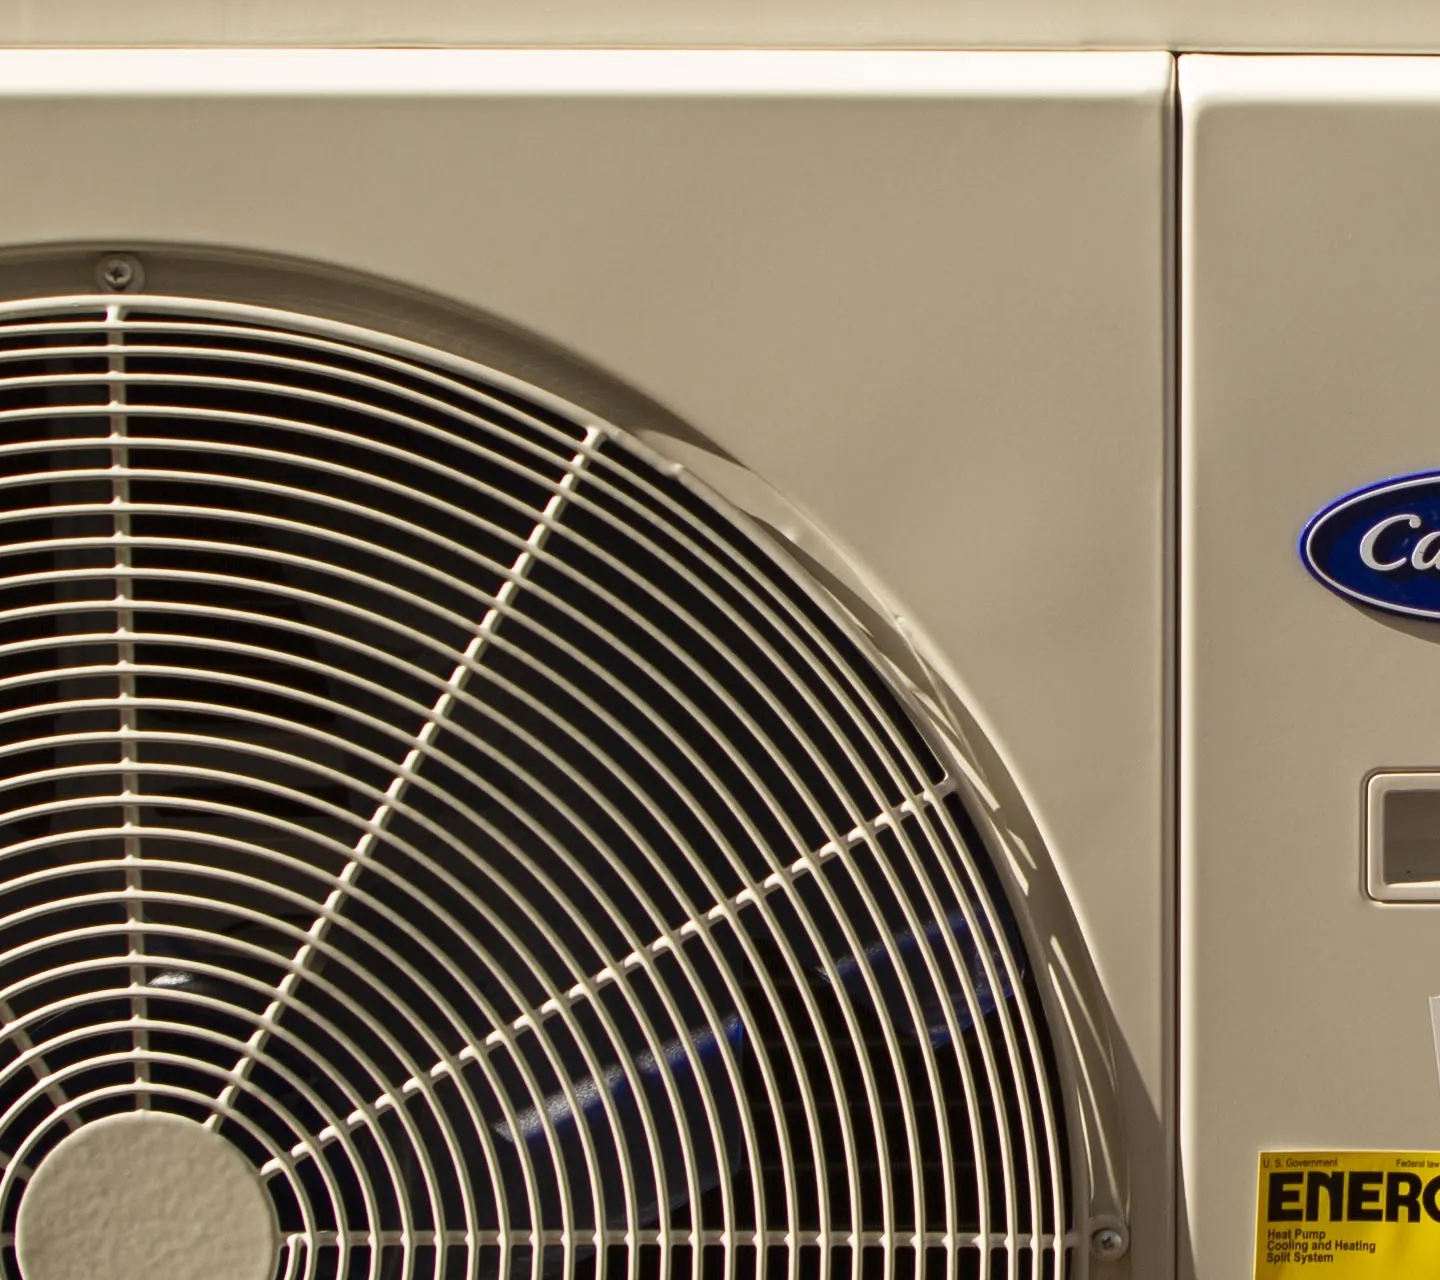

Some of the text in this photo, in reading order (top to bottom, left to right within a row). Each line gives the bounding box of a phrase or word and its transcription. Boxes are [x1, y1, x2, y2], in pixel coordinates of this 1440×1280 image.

[1286, 1158, 1338, 1167] Government
[1396, 1159, 1425, 1168] Federal
[1427, 1159, 1439, 1168] law
[1268, 1229, 1325, 1241] Heat Pump
[1267, 1240, 1376, 1254] Cooling and Heating
[1267, 1252, 1334, 1265] Split System
